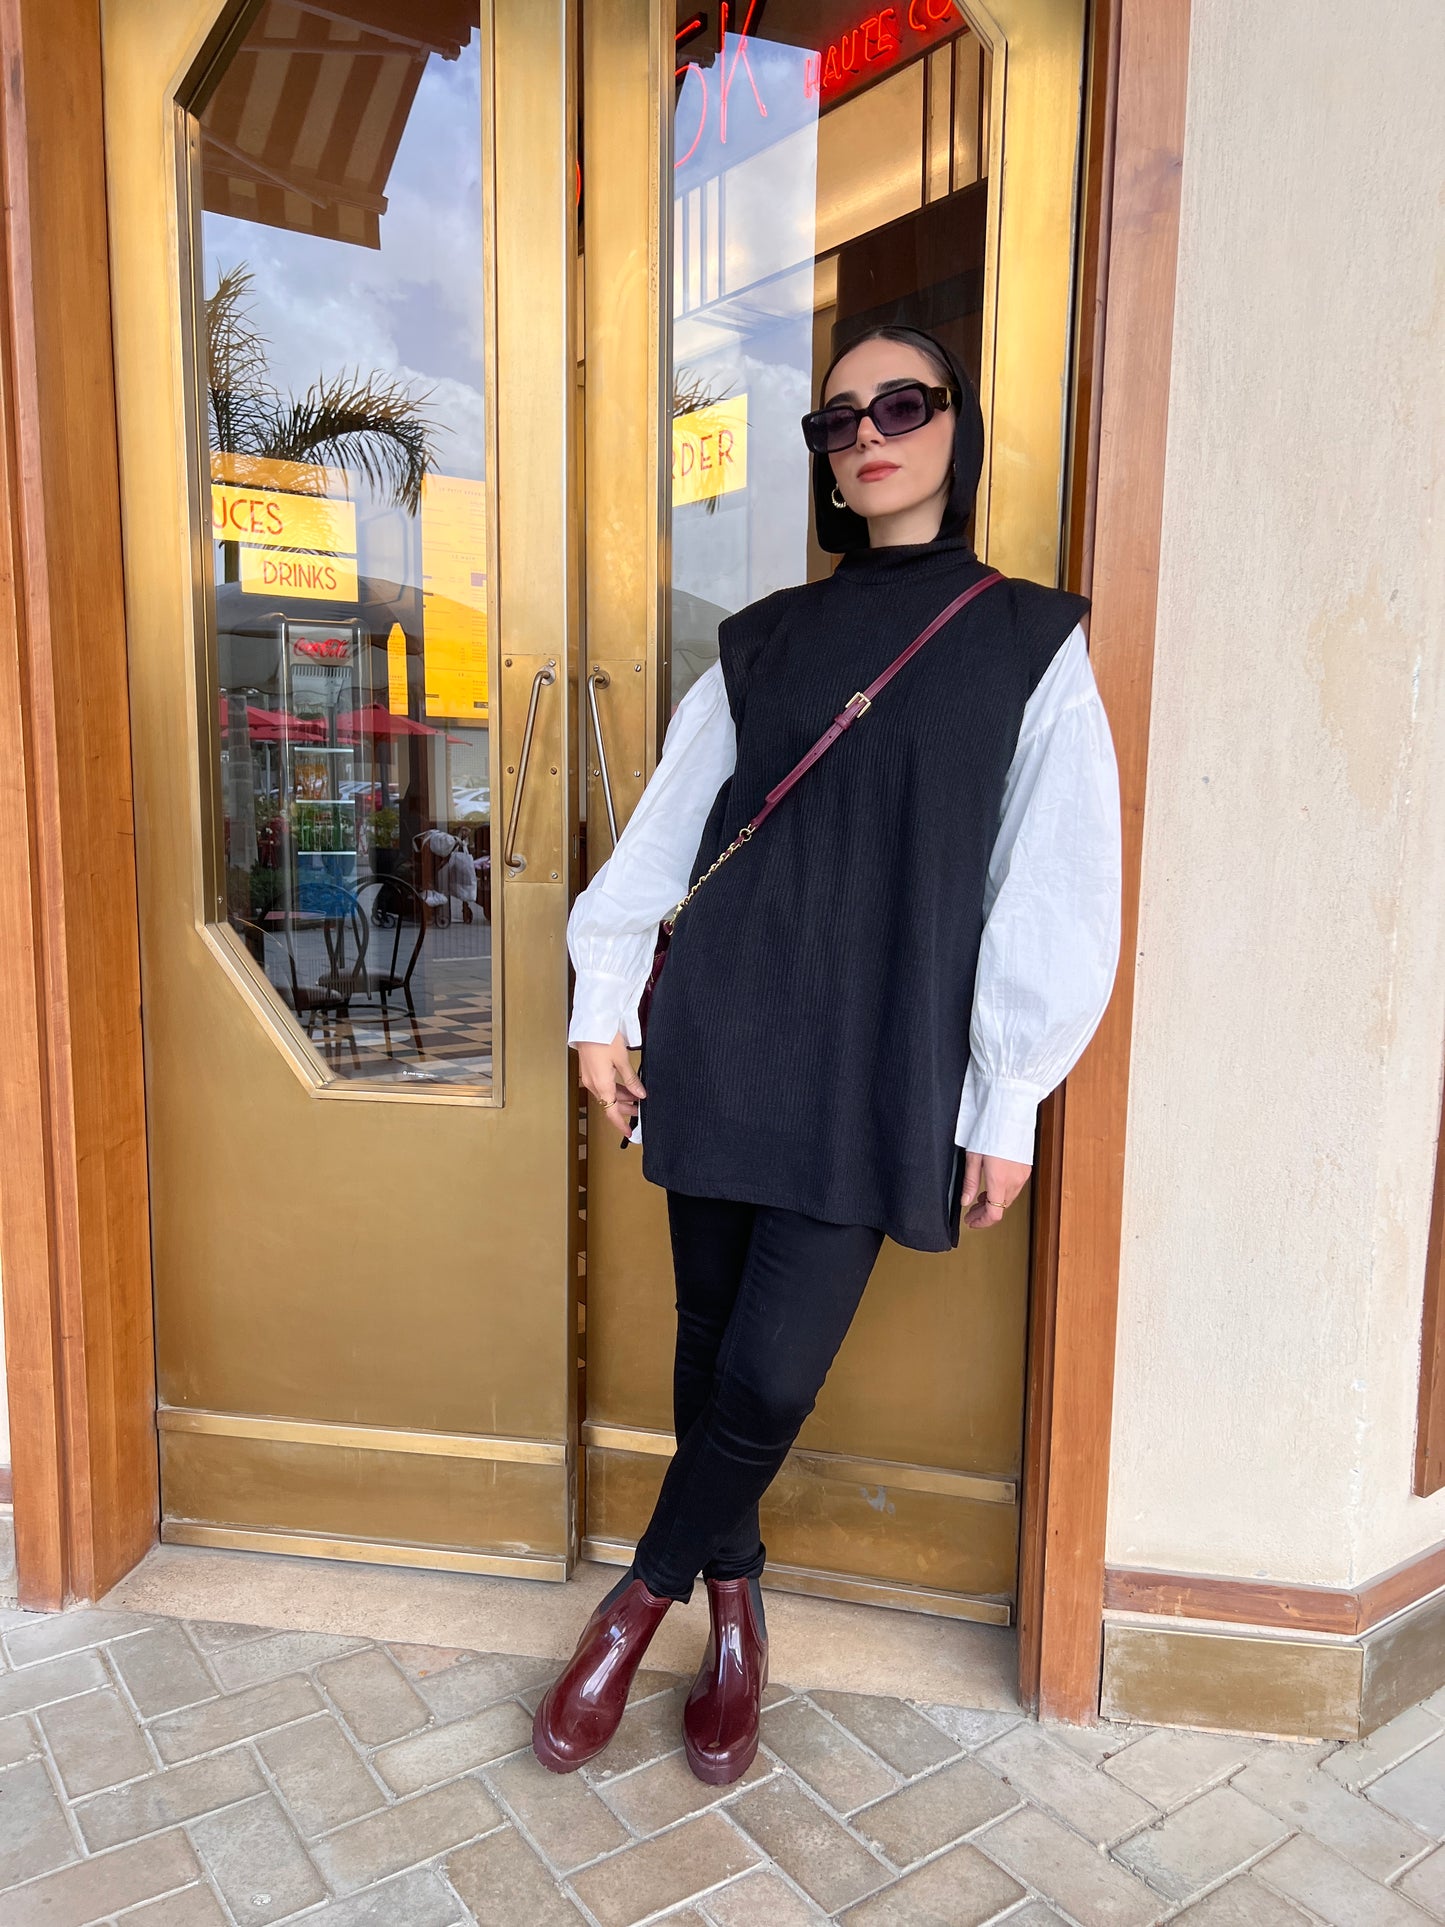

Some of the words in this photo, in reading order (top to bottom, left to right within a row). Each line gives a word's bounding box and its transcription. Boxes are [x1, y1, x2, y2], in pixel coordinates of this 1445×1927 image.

[803, 8, 895, 99] HAUTE
[211, 495, 283, 535] UCES
[263, 560, 337, 590] DRINKS
